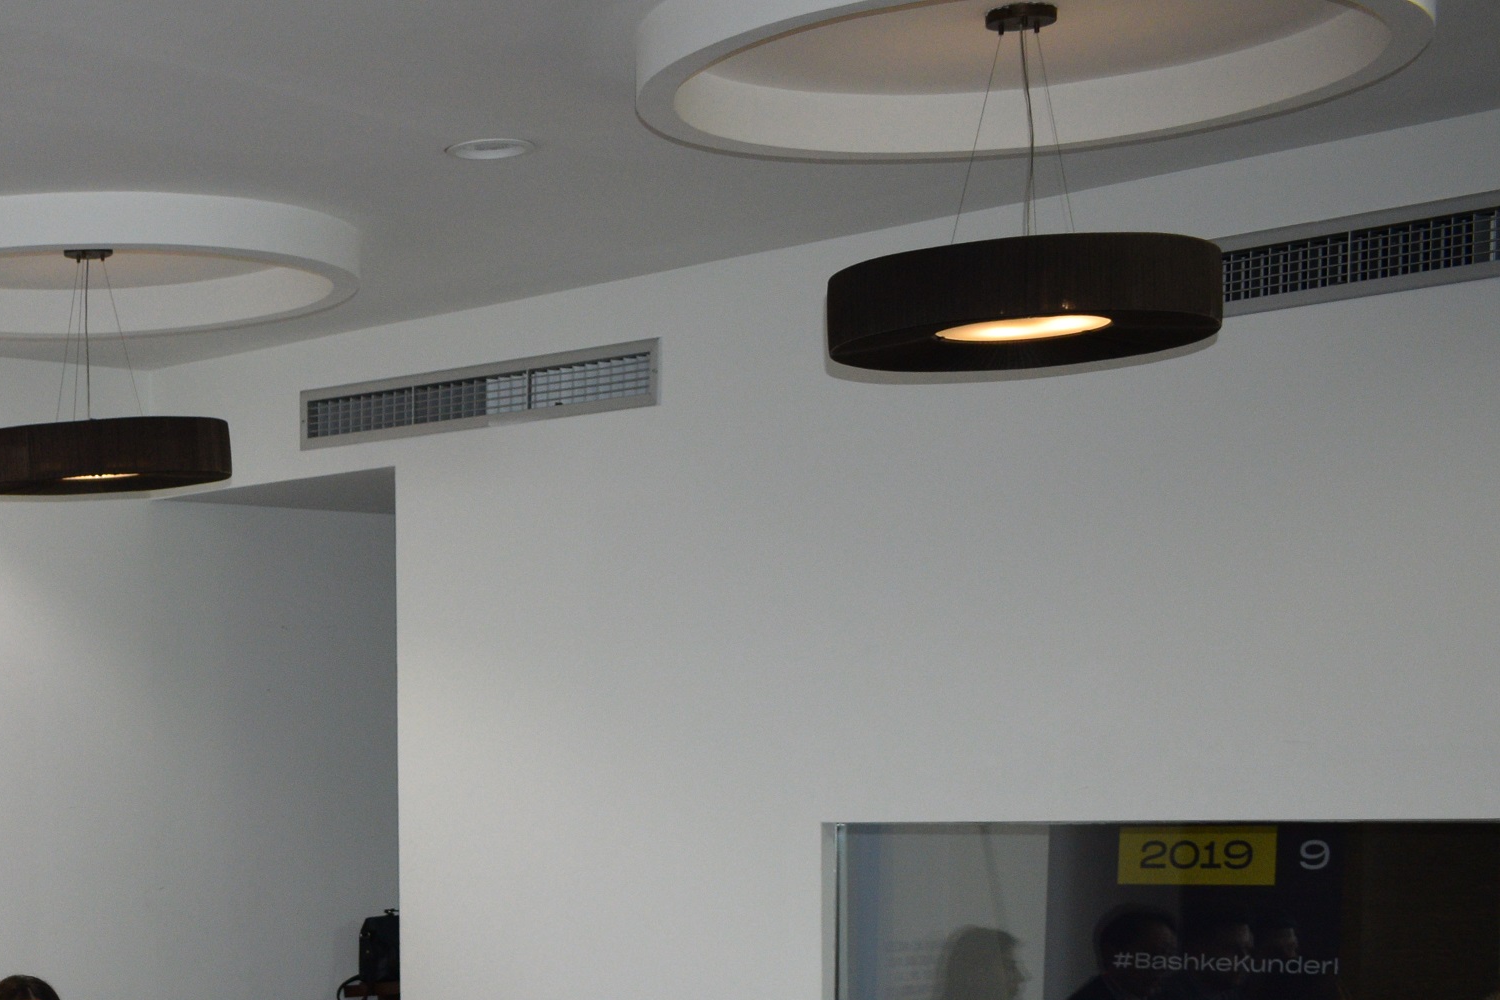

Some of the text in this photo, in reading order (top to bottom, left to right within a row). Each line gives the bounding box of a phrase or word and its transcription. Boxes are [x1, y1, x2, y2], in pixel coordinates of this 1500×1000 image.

[1139, 838, 1331, 871] 2019 9
[1112, 951, 1339, 976] #BashkeKunder
